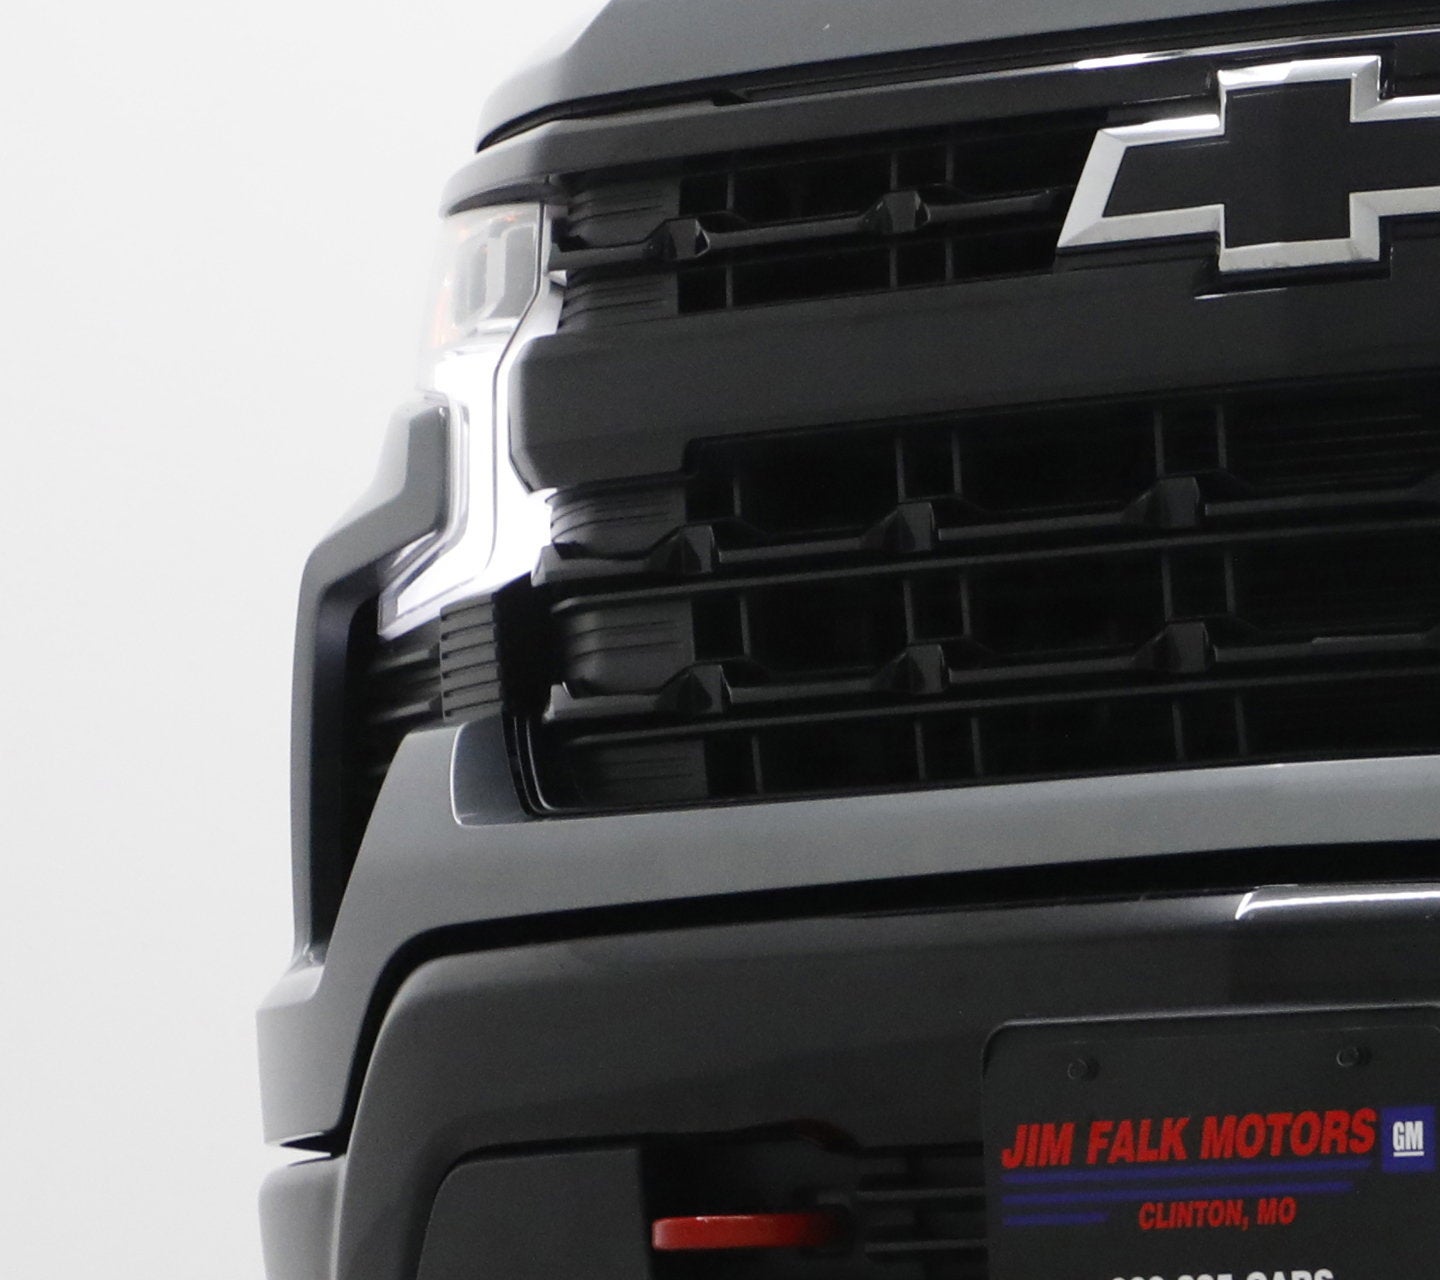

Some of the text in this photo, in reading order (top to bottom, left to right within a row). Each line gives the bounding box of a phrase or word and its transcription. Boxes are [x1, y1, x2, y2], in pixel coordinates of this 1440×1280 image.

[1001, 1108, 1378, 1169] JIM FALK MOTORS
[1392, 1120, 1425, 1152] GM
[1138, 1197, 1297, 1232] CLINTON, MO
